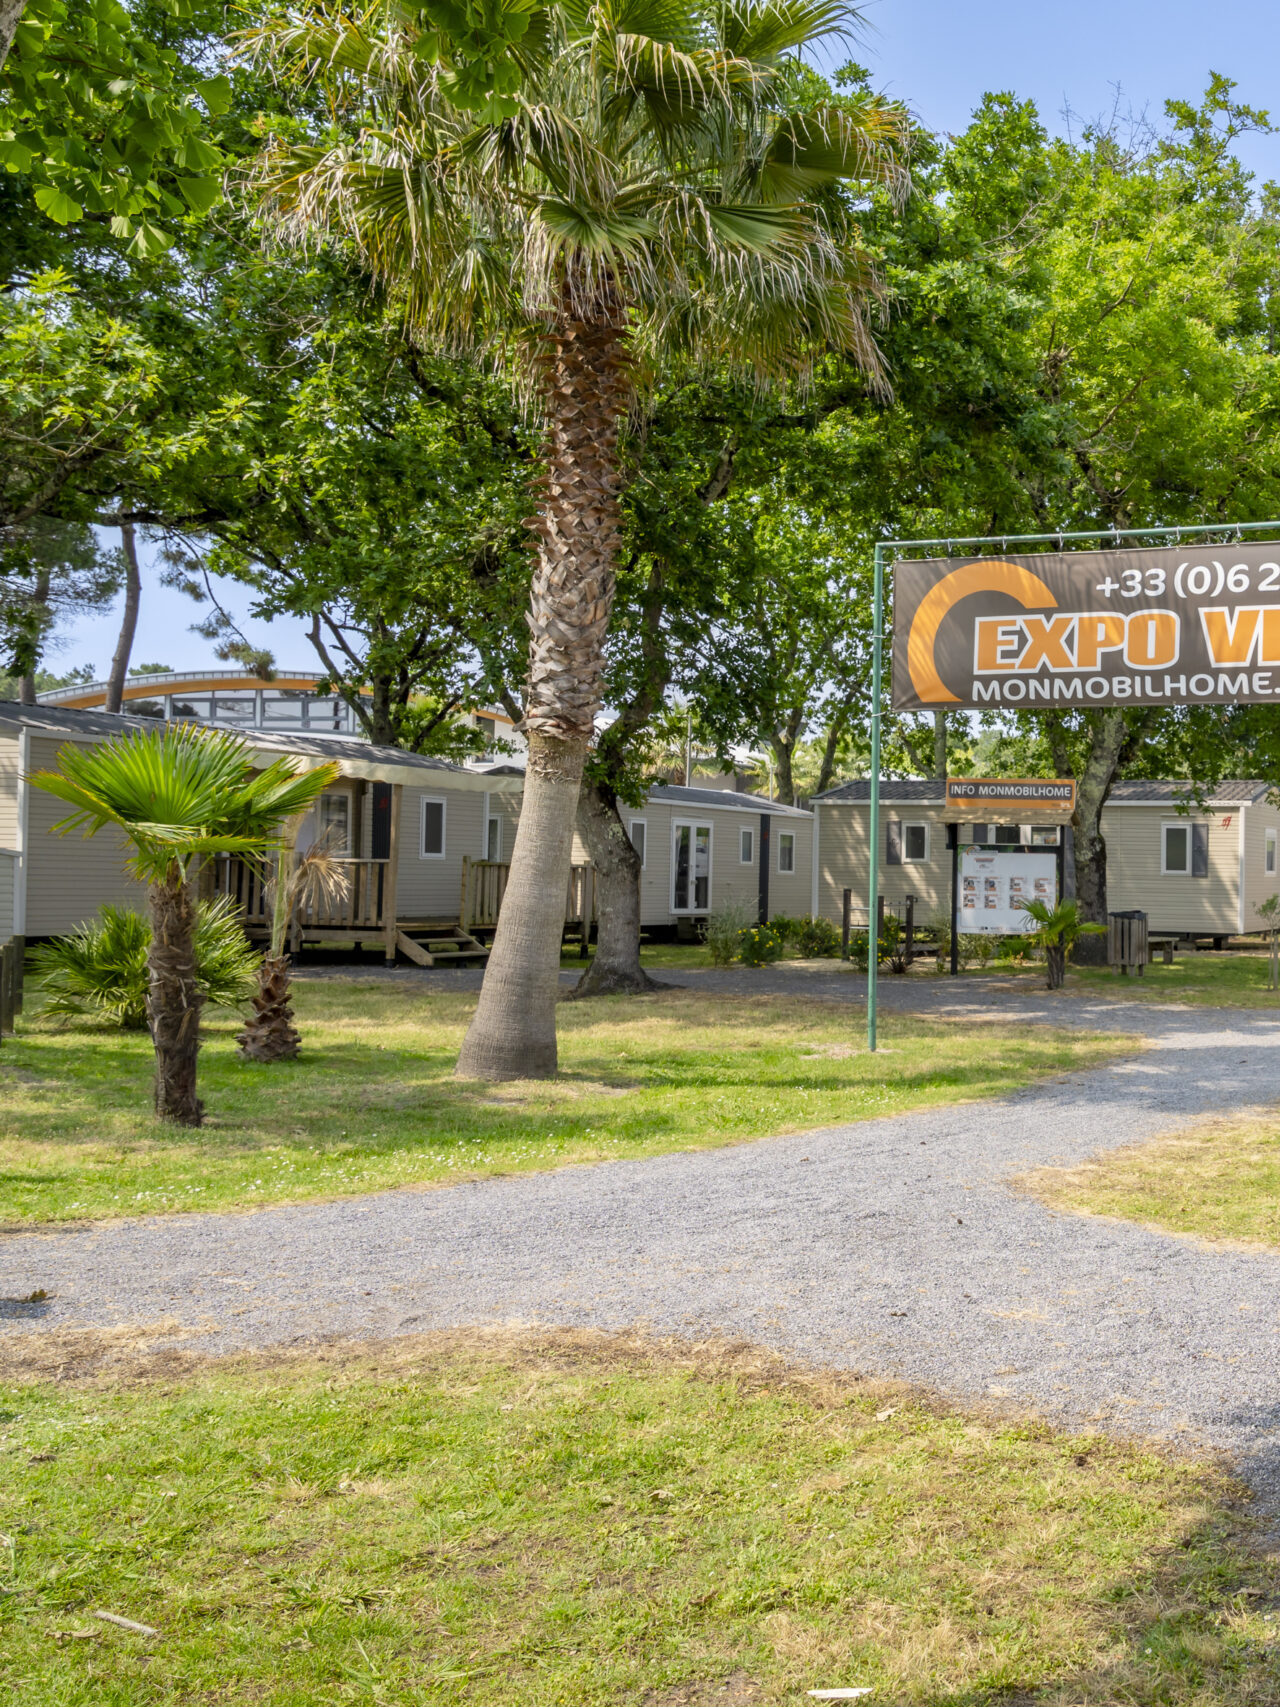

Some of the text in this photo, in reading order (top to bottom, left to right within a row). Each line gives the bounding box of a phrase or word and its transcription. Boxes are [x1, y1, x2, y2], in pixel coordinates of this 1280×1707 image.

[1096, 567, 1166, 598] +33
[1174, 561, 1250, 598] (0)6
[973, 608, 1181, 675] EXPO
[951, 785, 1071, 797] INFO MONMOBILHOME
